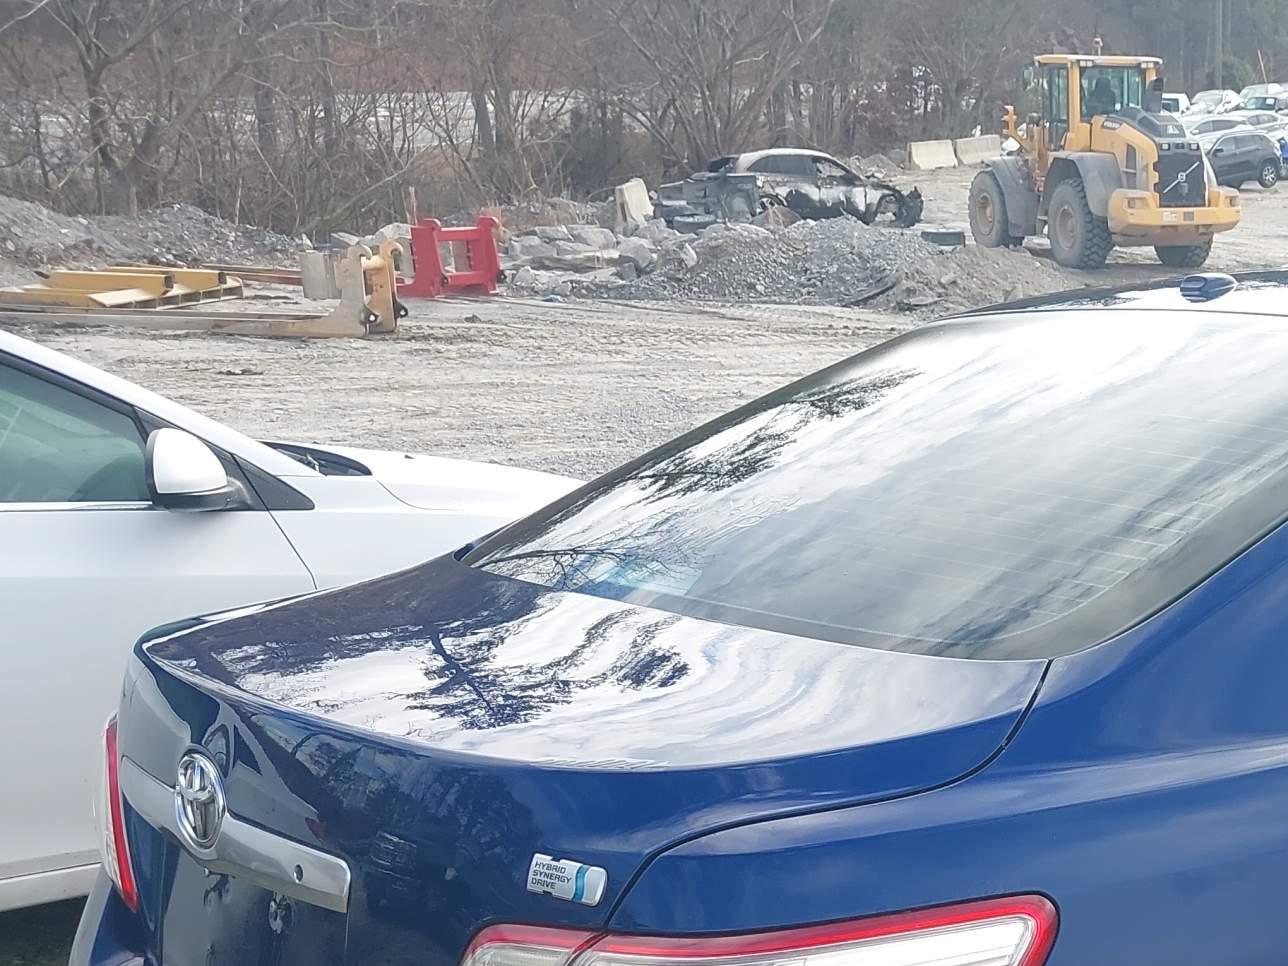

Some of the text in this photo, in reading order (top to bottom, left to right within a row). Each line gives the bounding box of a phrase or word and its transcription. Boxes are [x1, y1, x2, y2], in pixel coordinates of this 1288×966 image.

[534, 861, 567, 874] HYBRID
[530, 877, 557, 890] DRIVE
[532, 869, 572, 885] SYNERGY
